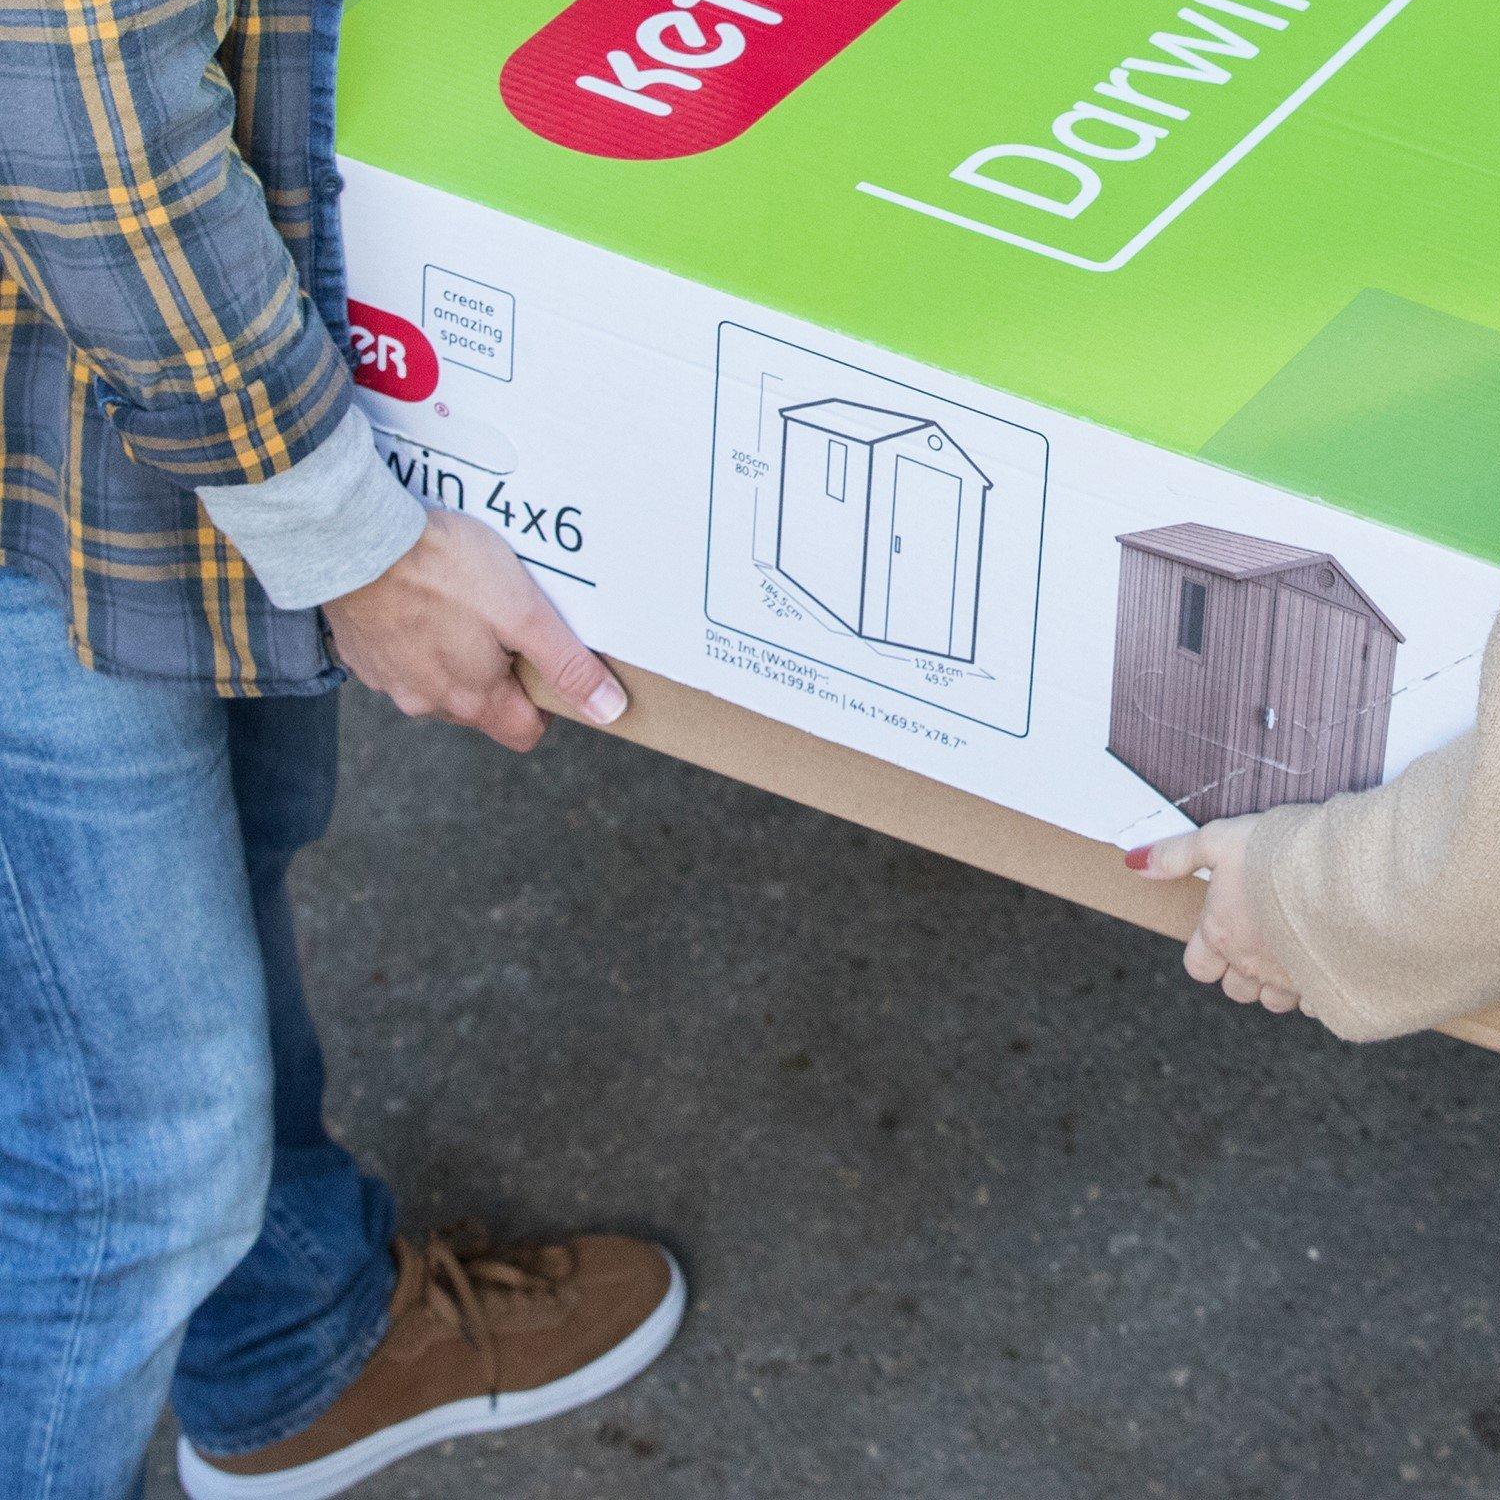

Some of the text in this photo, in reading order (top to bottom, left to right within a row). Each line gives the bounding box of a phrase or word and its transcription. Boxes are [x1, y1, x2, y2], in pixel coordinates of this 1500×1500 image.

[443, 287, 495, 318] create
[433, 306, 504, 343] amazing
[440, 326, 496, 359] spaces
[731, 448, 770, 472] 205cm
[735, 463, 765, 480] 80.7"
[386, 449, 584, 553] win 4x6
[705, 628, 734, 649] Dim.
[705, 644, 815, 695] 112x176.5x199.8
[818, 688, 839, 704] cm
[913, 658, 964, 678] 125.8cm
[924, 673, 954, 688] 49.5"
